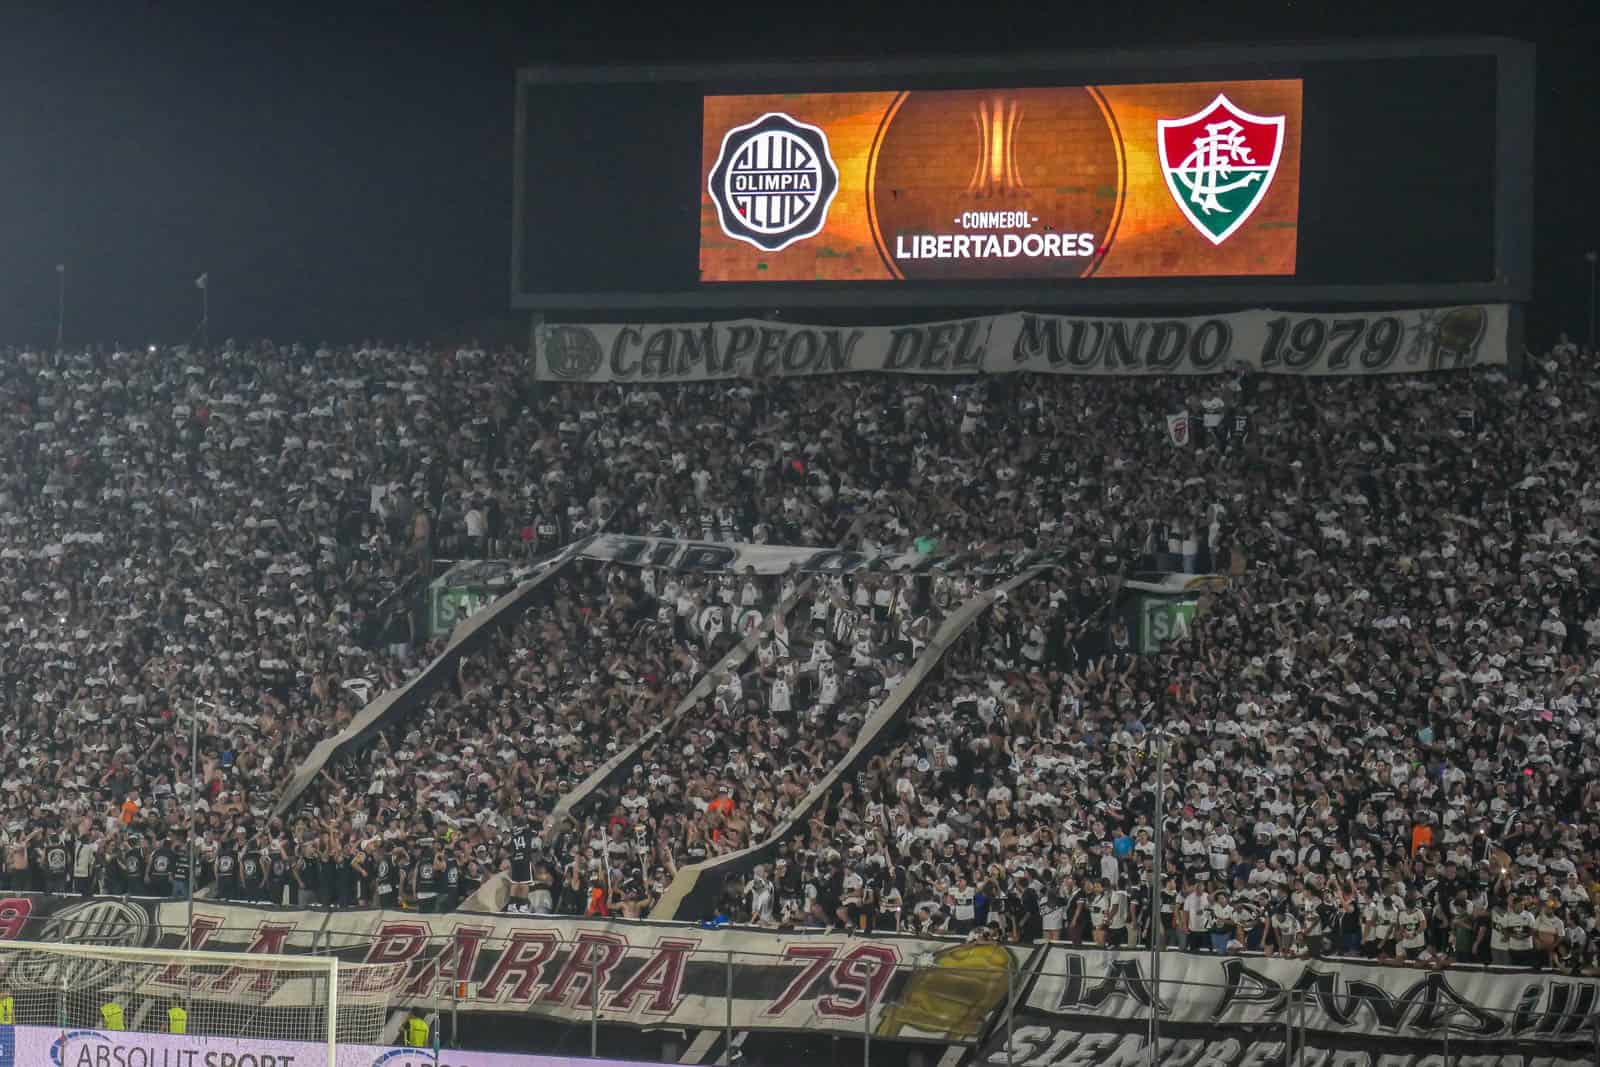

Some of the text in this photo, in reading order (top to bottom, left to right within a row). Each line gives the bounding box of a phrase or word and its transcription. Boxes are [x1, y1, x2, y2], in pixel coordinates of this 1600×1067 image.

[735, 174, 811, 191] OLIMPIA
[896, 233, 1094, 259] LIBERTADORES
[609, 321, 864, 378] CAMPEON
[882, 319, 992, 371] DEL
[1012, 313, 1234, 371] MUNDO
[1261, 316, 1405, 370] 1979
[144, 912, 299, 994] LA
[344, 919, 702, 1016] BARRA
[757, 941, 903, 1024] 79
[1057, 952, 1172, 1018] LA
